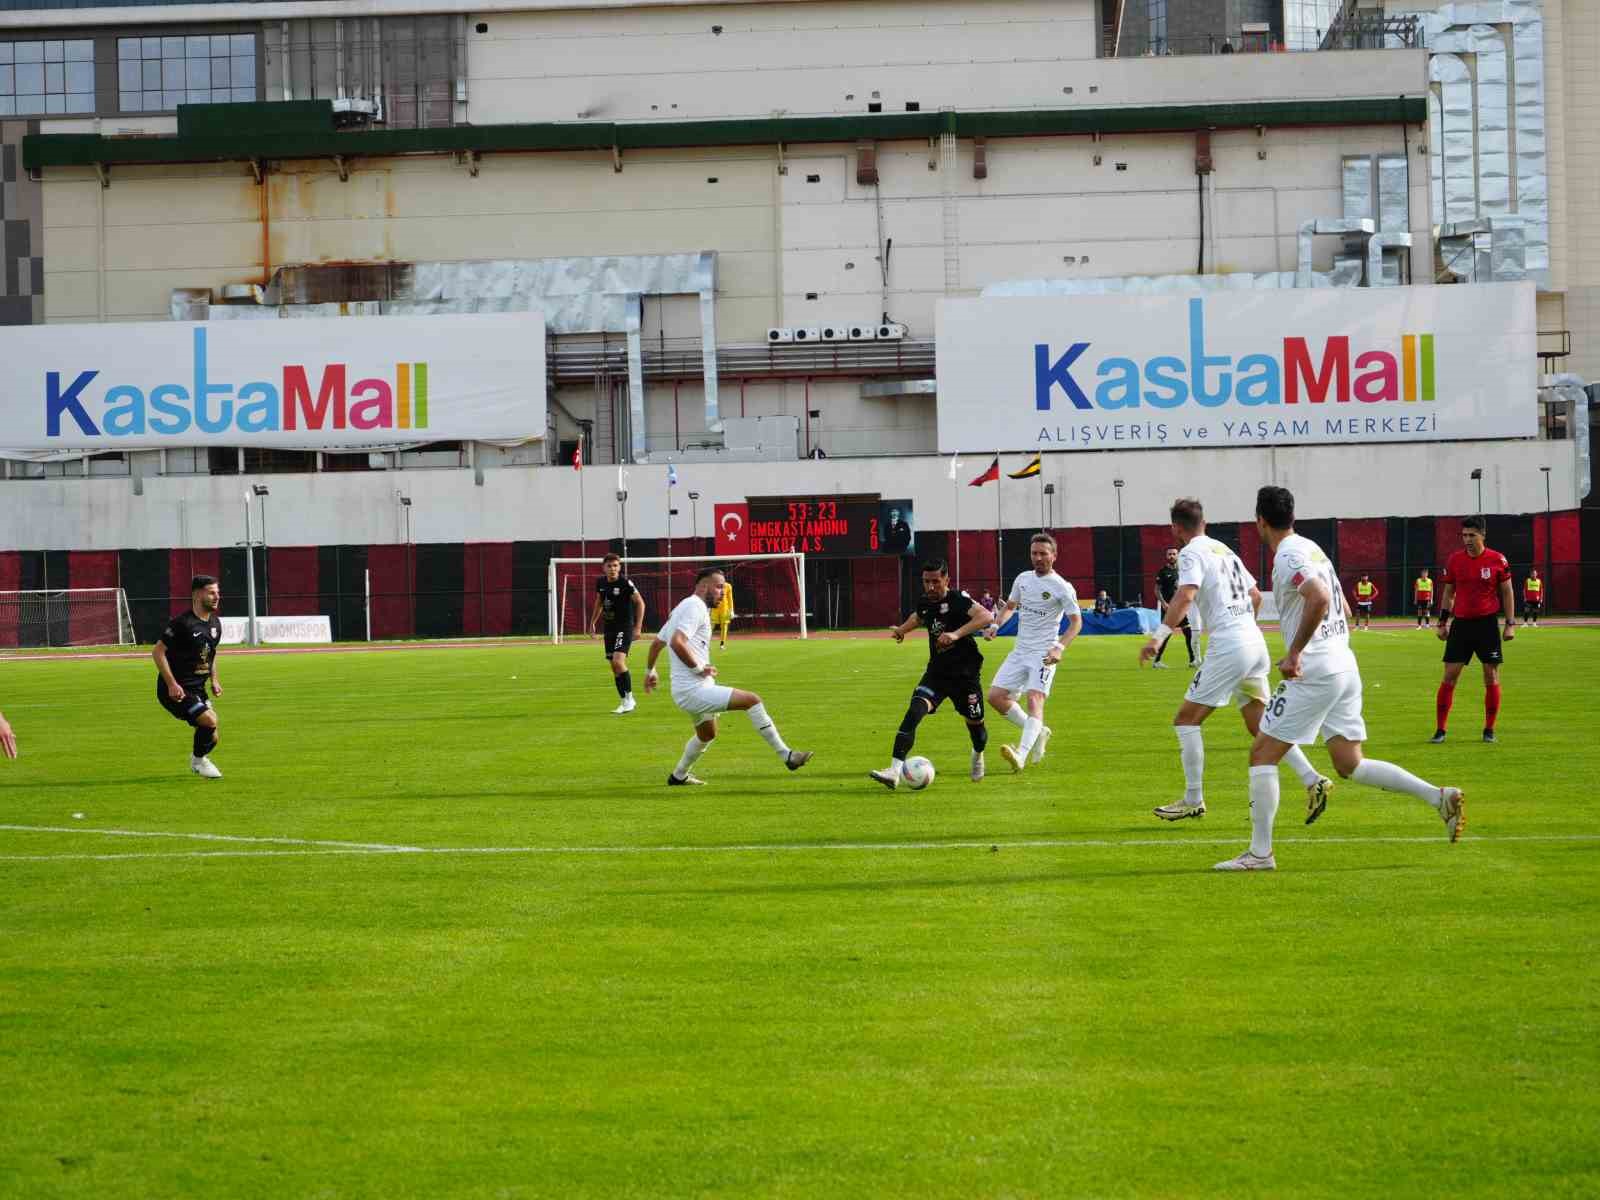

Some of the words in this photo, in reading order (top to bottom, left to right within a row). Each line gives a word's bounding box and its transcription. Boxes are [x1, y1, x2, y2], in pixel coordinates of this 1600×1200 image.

[46, 328, 428, 436] KastaMall
[1035, 299, 1435, 411] KastaMall
[1037, 422, 1168, 446] ALIŞVERİŞ
[1183, 427, 1208, 439] ve
[1223, 419, 1311, 441] YAŞAM
[1325, 415, 1437, 436] MERKEZİ
[870, 519, 878, 534] 2
